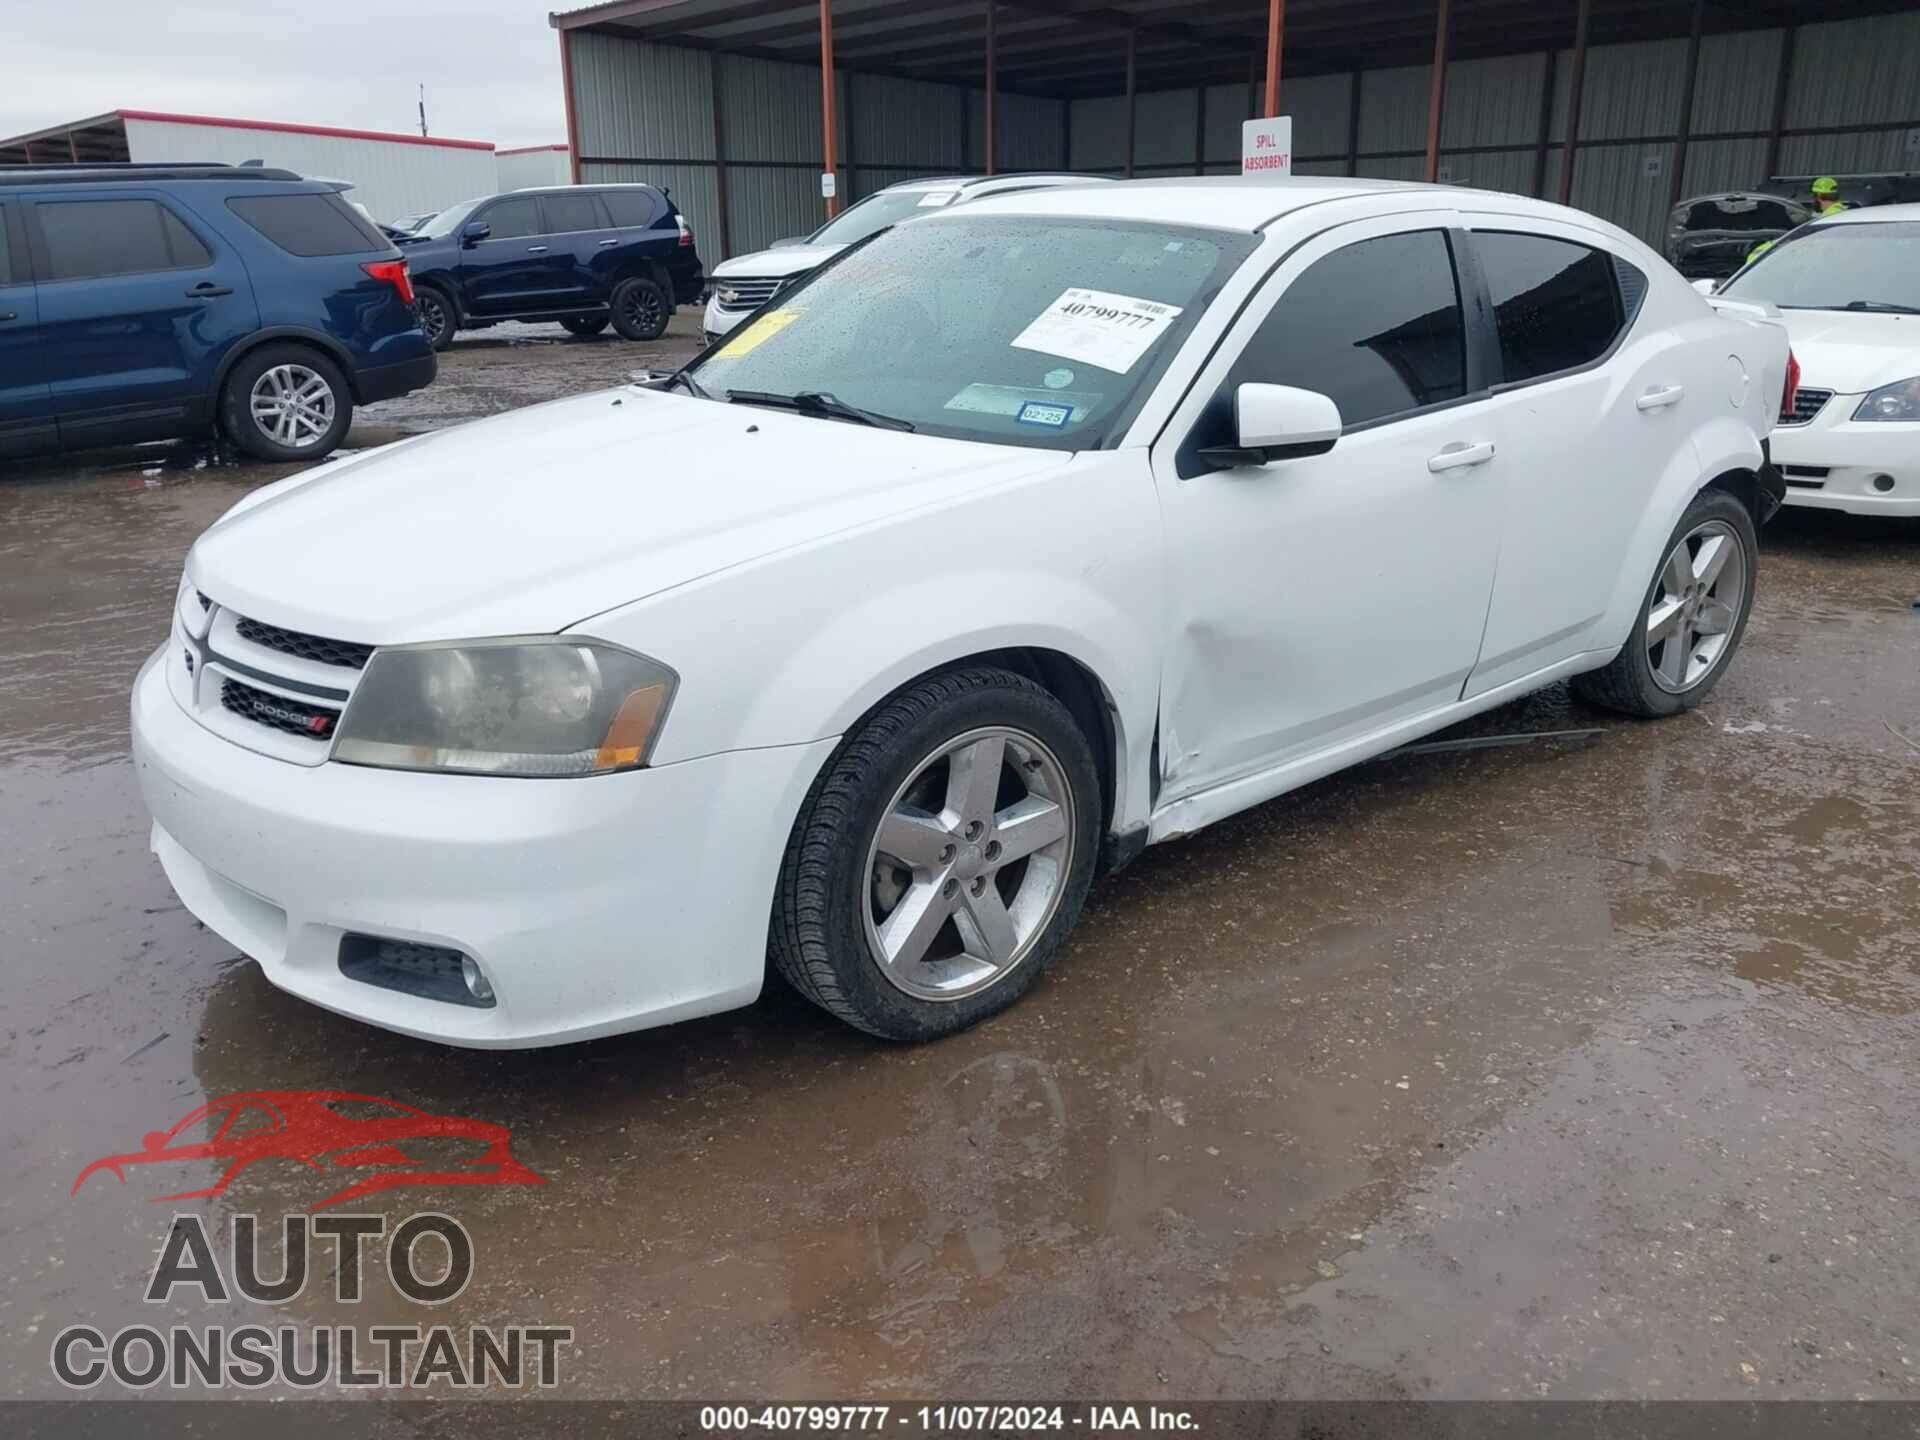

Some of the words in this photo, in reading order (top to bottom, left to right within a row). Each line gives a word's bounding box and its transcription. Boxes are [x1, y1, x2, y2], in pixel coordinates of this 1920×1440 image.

[1256, 134, 1277, 148] SPILL
[1245, 154, 1288, 170] ABSORBENT
[1060, 302, 1155, 329] 40799777
[253, 701, 313, 725] DODGE
